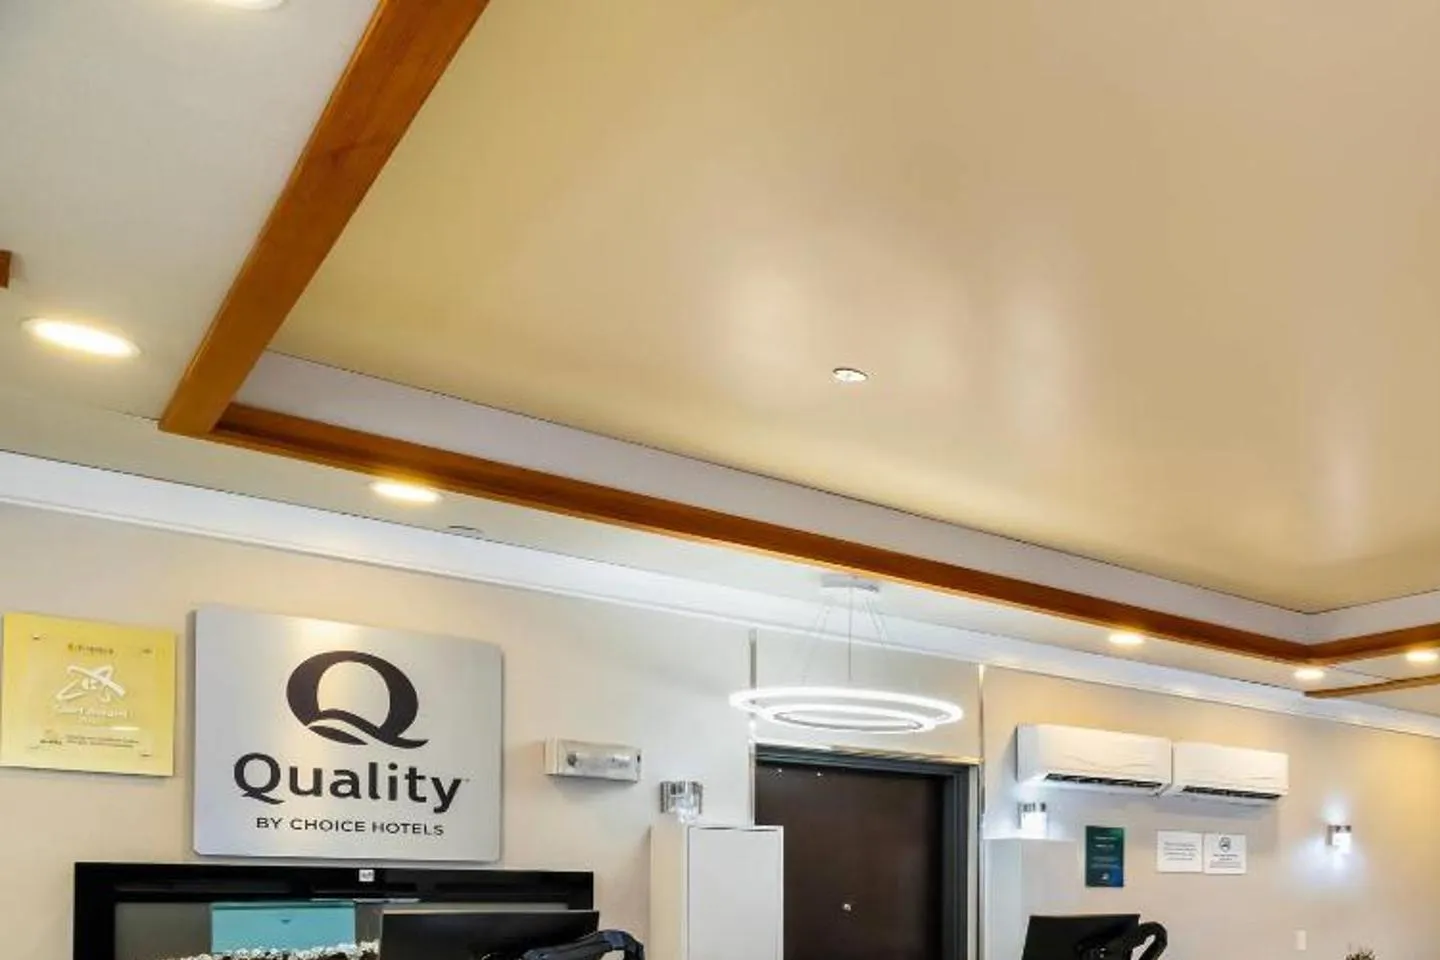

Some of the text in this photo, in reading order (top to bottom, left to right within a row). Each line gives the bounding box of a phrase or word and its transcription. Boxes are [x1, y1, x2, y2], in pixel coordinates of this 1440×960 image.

[286, 650, 430, 750] Q
[233, 752, 463, 815] Quality
[256, 816, 445, 837] BY CHOICE HOTELS
